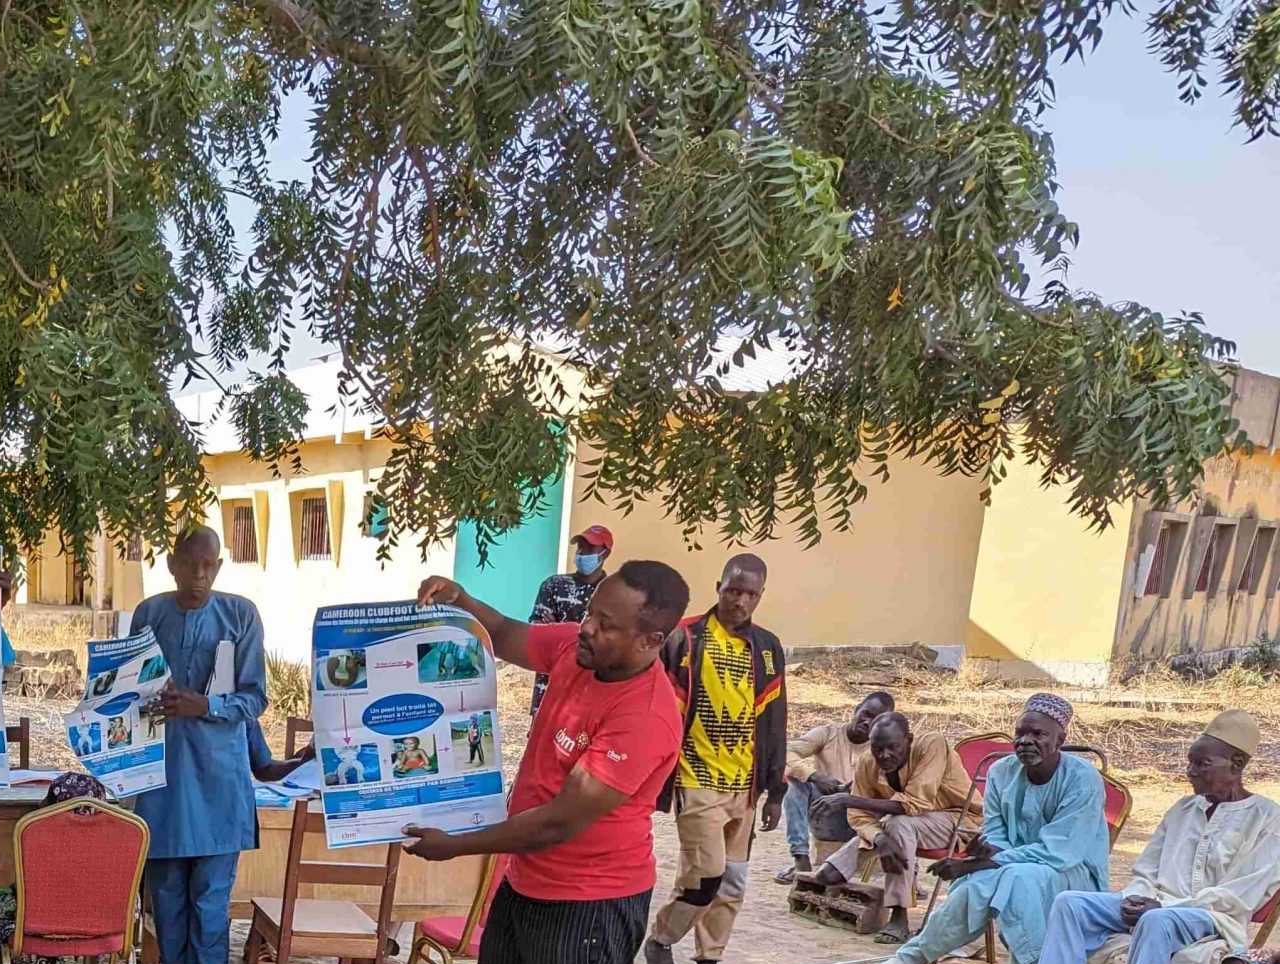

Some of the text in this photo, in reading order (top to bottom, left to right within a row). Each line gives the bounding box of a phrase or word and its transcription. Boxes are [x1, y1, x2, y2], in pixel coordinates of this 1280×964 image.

[322, 608, 366, 620] CAMEROON
[367, 605, 414, 617] CLUBFOOT
[371, 713, 395, 721] permet
[401, 709, 426, 717] l'enfant
[380, 706, 395, 714] pied
[555, 728, 575, 752] cbm
